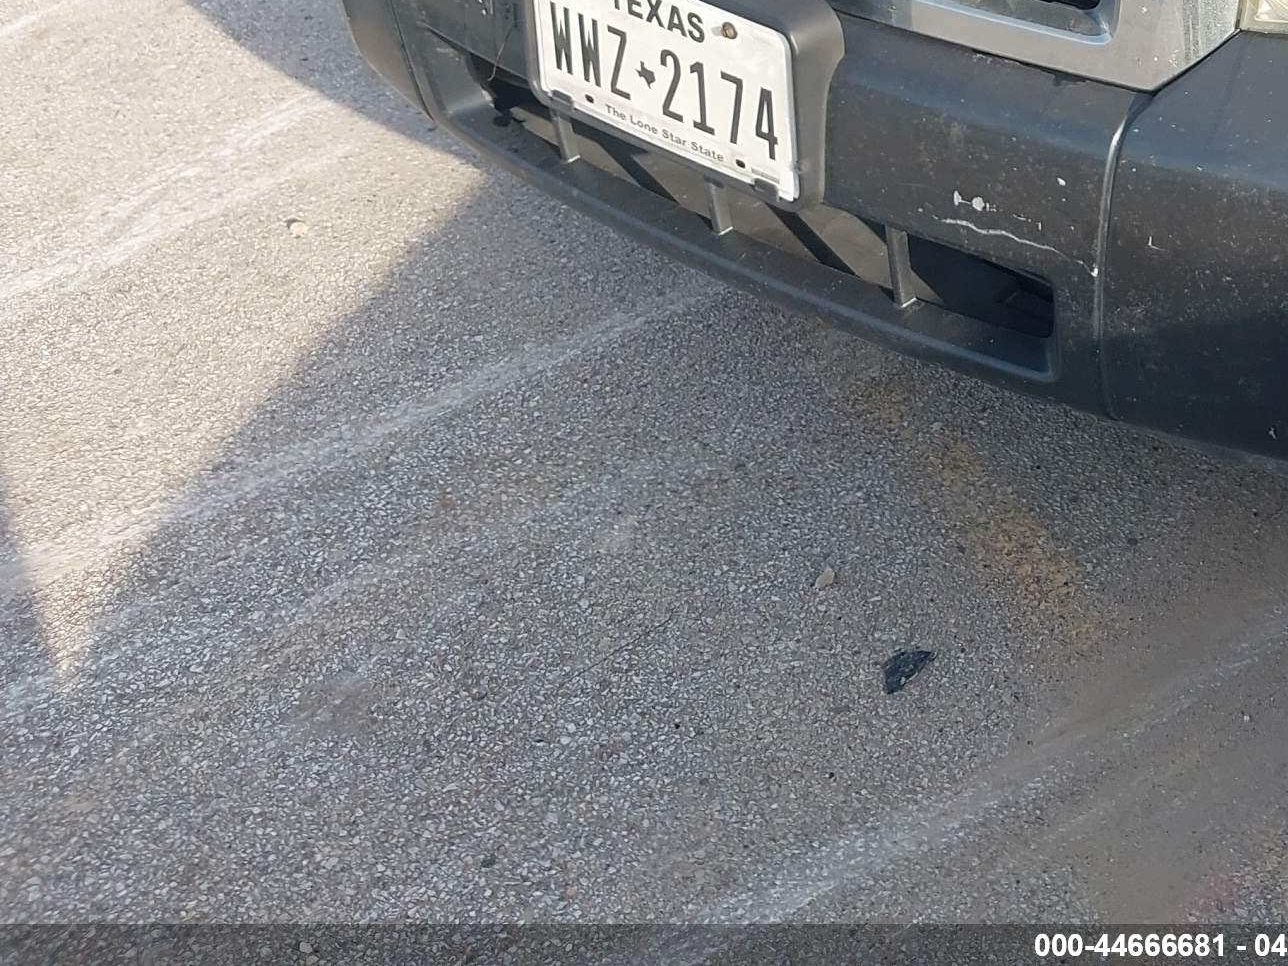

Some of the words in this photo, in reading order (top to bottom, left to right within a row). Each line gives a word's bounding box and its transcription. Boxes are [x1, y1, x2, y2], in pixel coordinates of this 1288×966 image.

[550, 1, 631, 100] WWZ
[660, 49, 778, 161] 2174
[605, 104, 626, 121] The
[630, 114, 659, 134] Lone
[661, 128, 687, 147] Star
[690, 140, 725, 163] State
